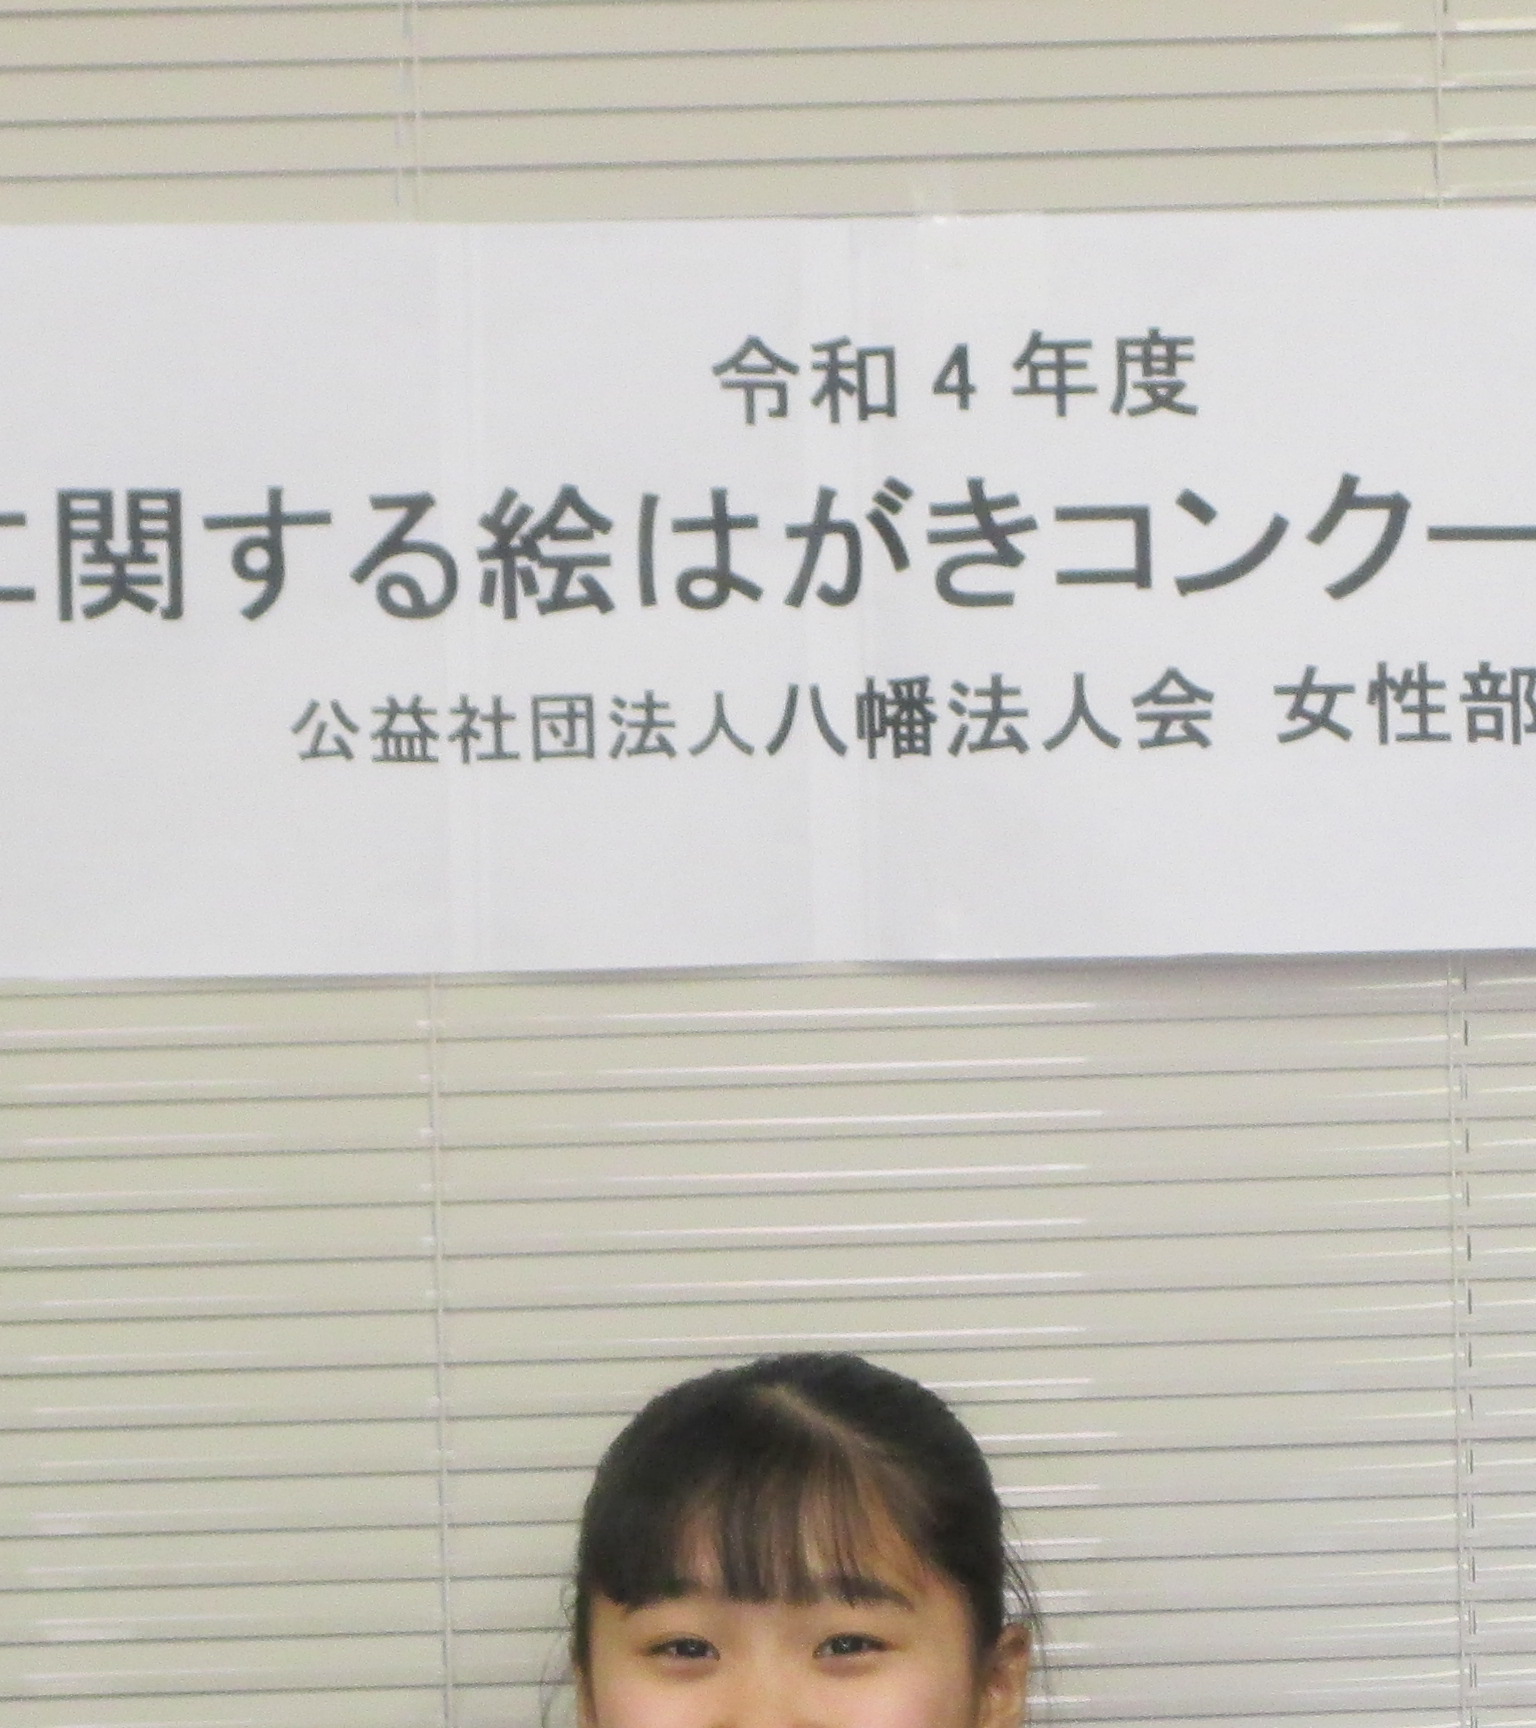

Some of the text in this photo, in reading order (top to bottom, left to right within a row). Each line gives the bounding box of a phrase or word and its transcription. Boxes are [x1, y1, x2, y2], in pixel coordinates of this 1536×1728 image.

[712, 329, 1199, 426] 令和4年度
[289, 666, 1215, 764] 公益社団法人八幡法人会
